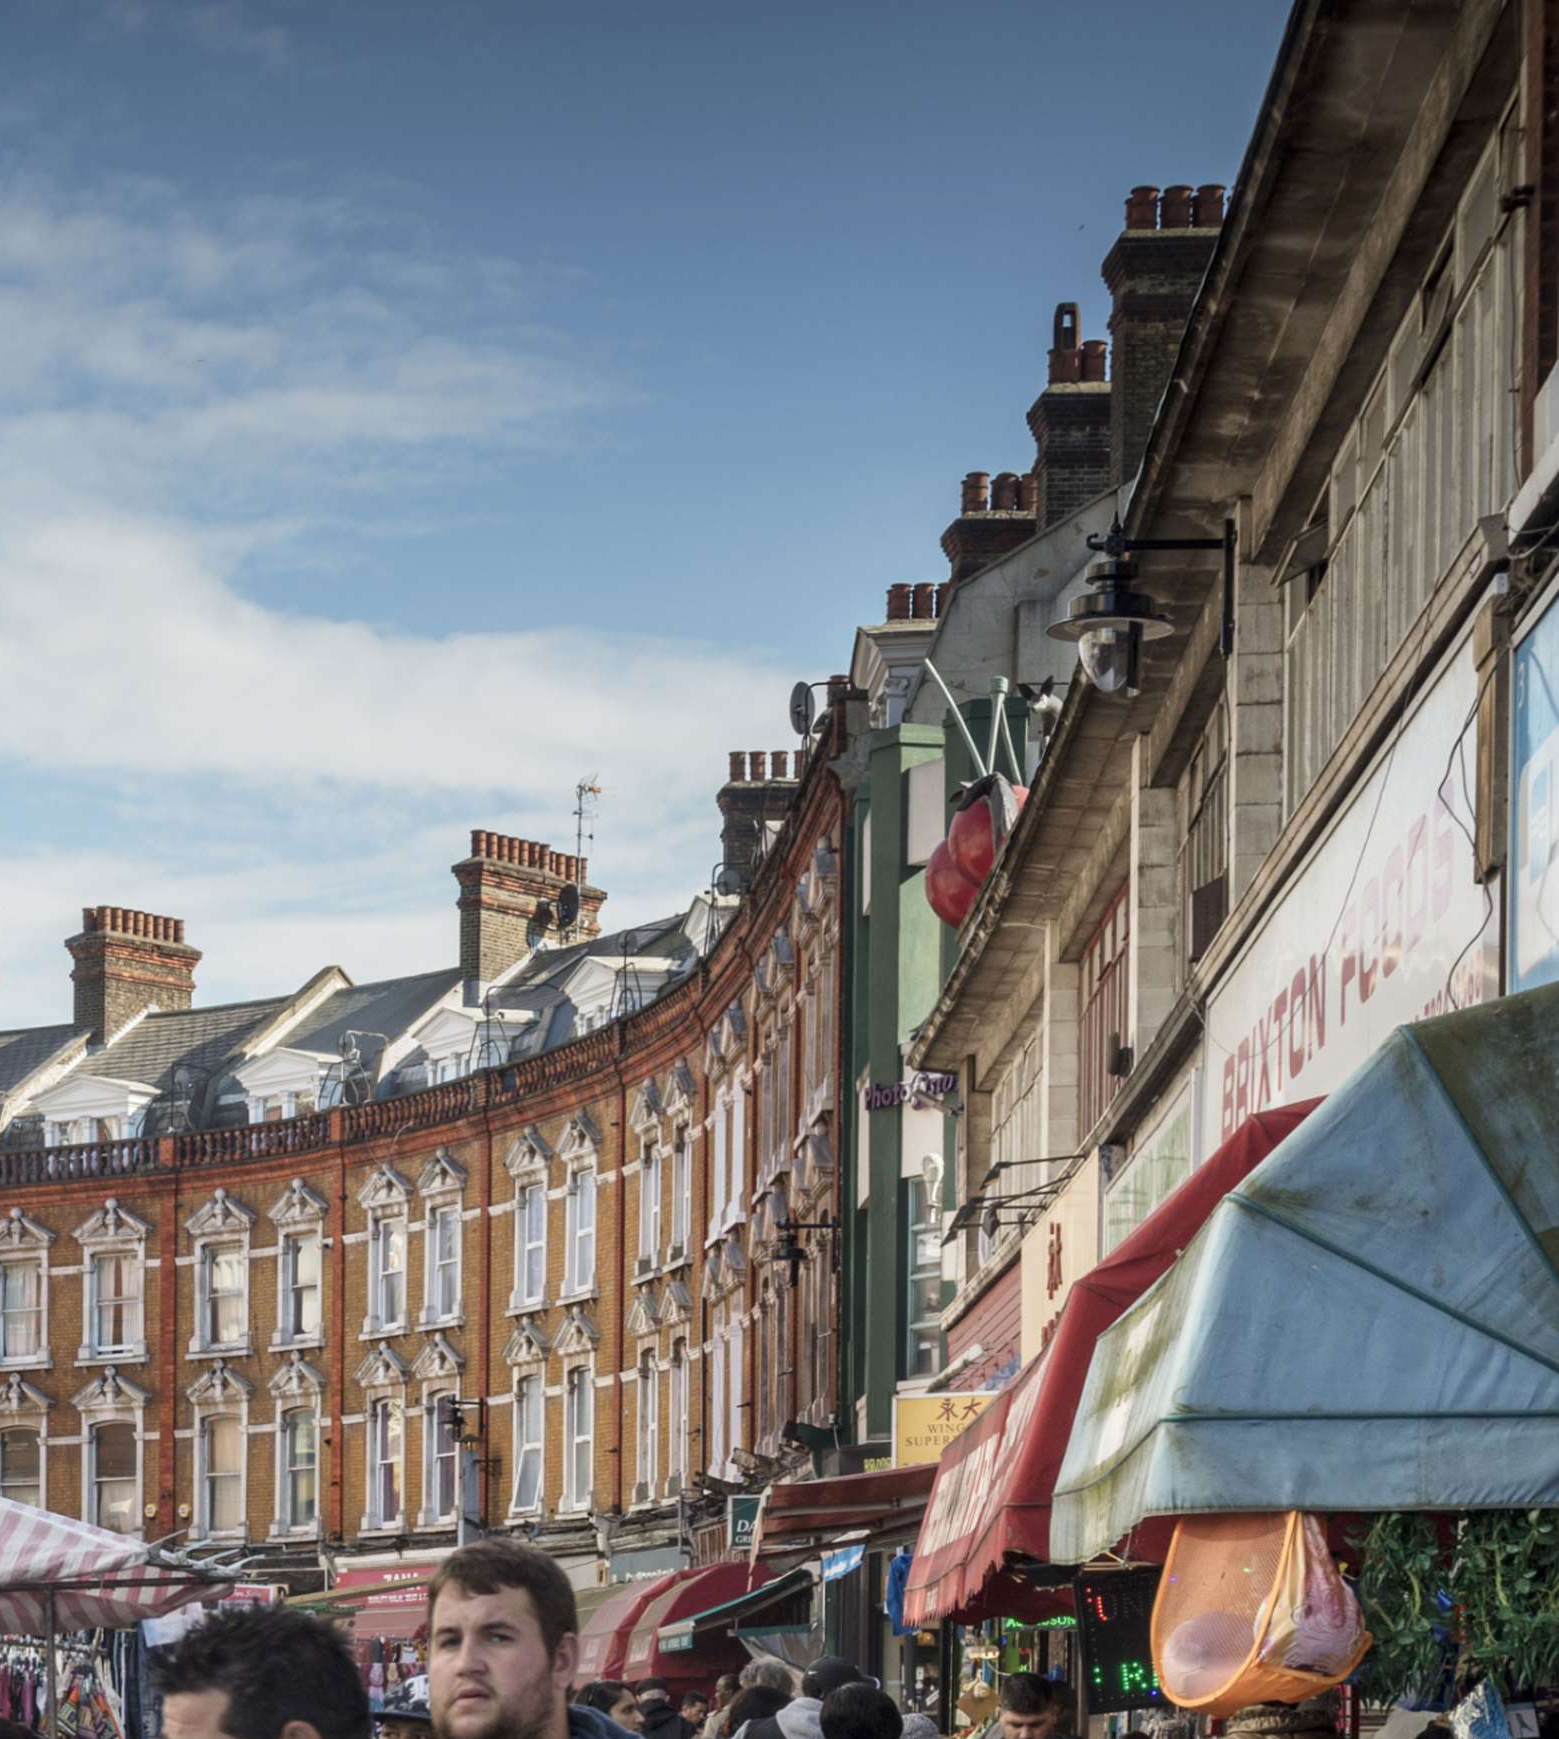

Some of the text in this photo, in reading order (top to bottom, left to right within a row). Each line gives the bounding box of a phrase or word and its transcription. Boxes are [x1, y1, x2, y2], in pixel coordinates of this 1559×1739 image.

[1222, 954, 1326, 1143] BRIXTON
[1341, 780, 1453, 1026] FOODS
[936, 1397, 982, 1421] 永大
[927, 1423, 964, 1433] WING
[905, 1435, 954, 1447] SUPER
[736, 1519, 758, 1533] DA
